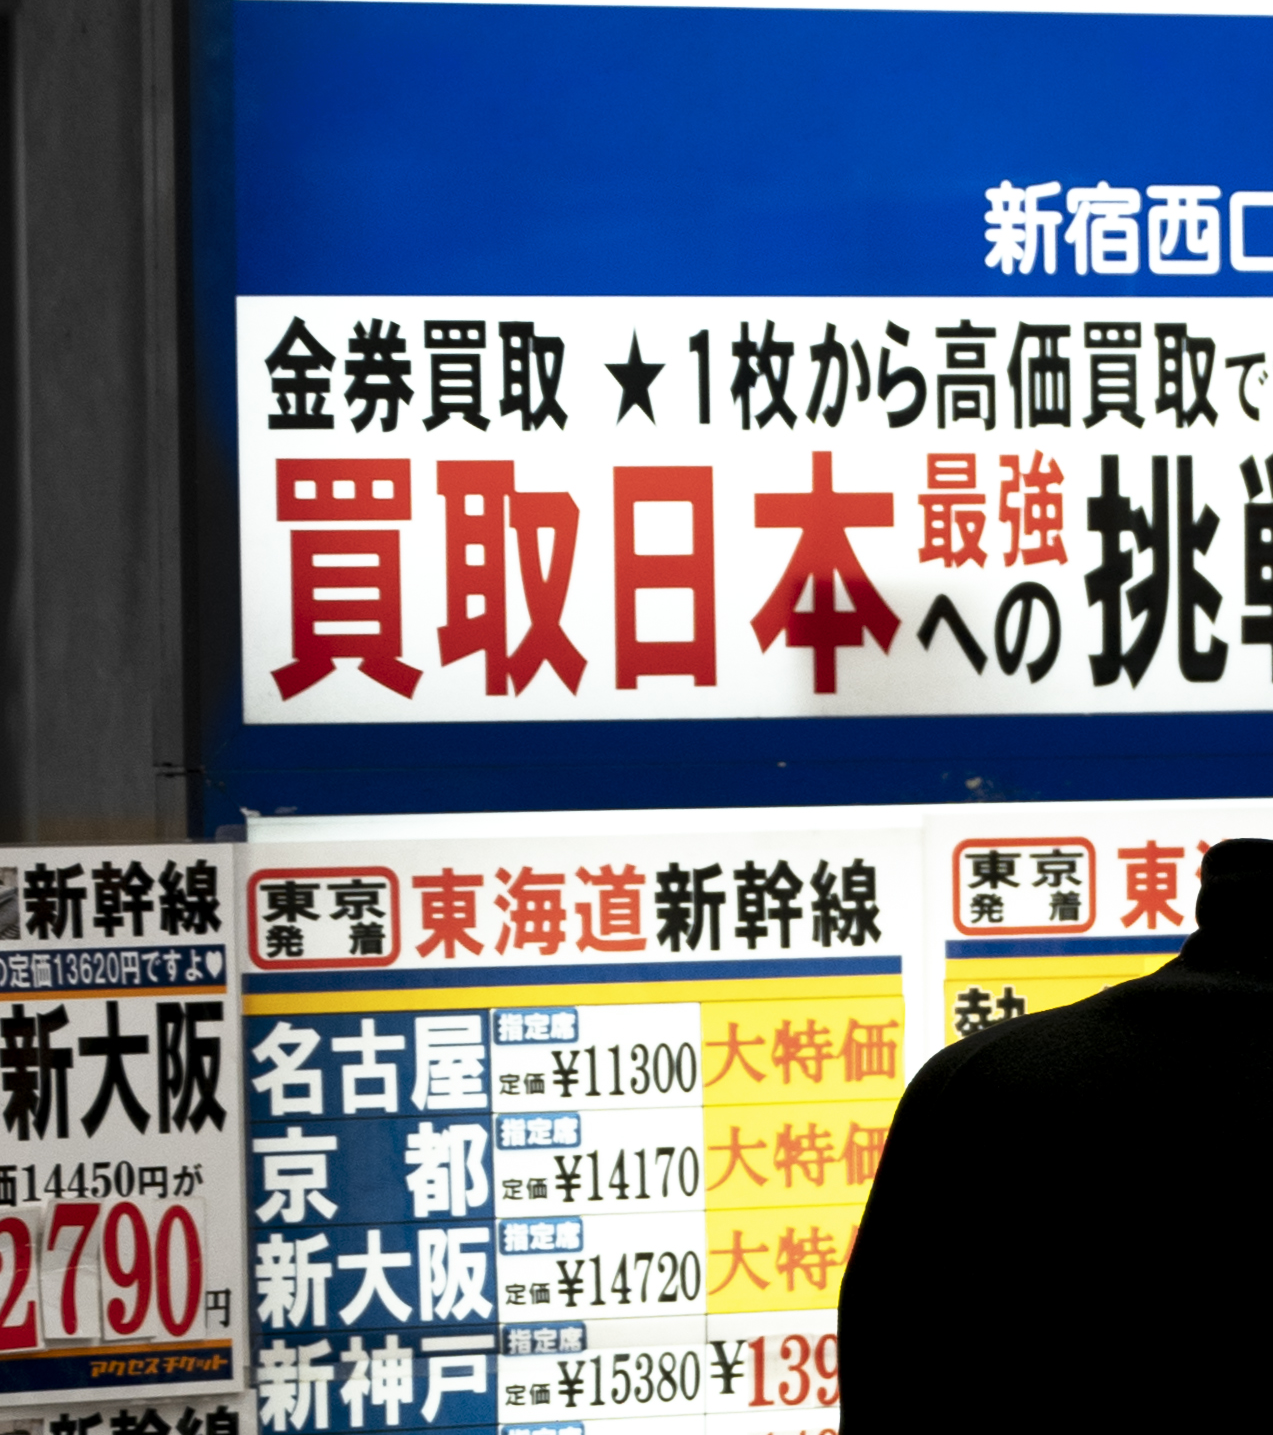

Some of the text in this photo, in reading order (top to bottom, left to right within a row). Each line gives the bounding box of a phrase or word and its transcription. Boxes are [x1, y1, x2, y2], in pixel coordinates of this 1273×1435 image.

[264, 316, 571, 433] 金券買取
[917, 451, 1071, 571] 最強
[270, 451, 902, 702] 買取日本
[915, 579, 1063, 686] への
[23, 859, 223, 944] 新幹線
[259, 879, 389, 923] 東京
[265, 921, 387, 959] 発着
[411, 857, 883, 960] 東海道新幹線
[0, 999, 229, 1141] 新大阪
[252, 1013, 900, 1117] 名古屋 大特価
[256, 1228, 495, 1329] 新大阪
[258, 1333, 496, 1433] 新神戸
